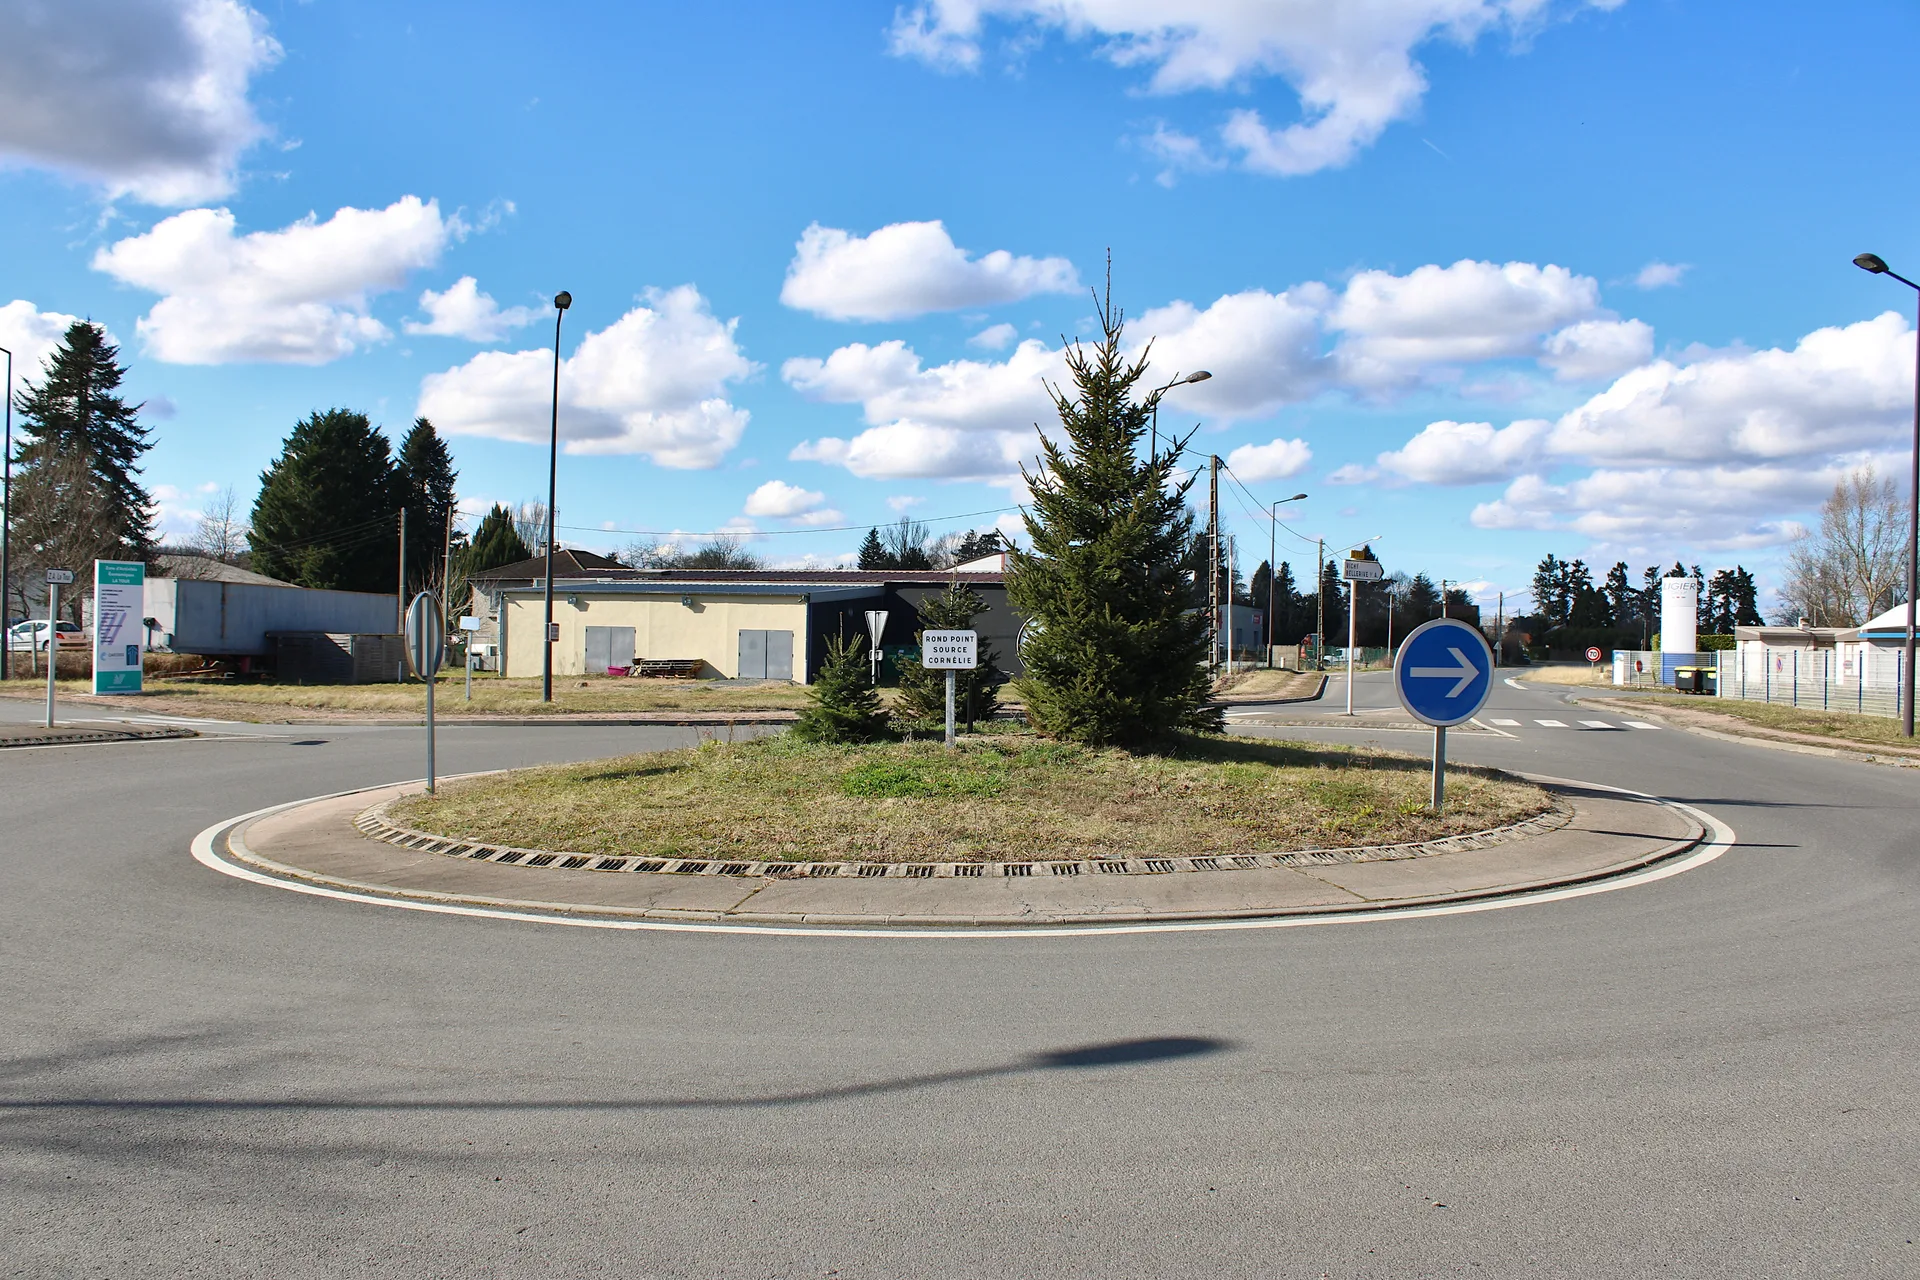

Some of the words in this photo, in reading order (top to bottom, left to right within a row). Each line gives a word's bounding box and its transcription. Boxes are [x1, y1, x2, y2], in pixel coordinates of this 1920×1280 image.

[1663, 582, 1697, 591] LIGIER
[925, 635, 948, 643] ROND
[950, 635, 975, 643] POINT
[933, 646, 968, 654] SOURCE
[928, 656, 972, 664] CORNÉLIE
